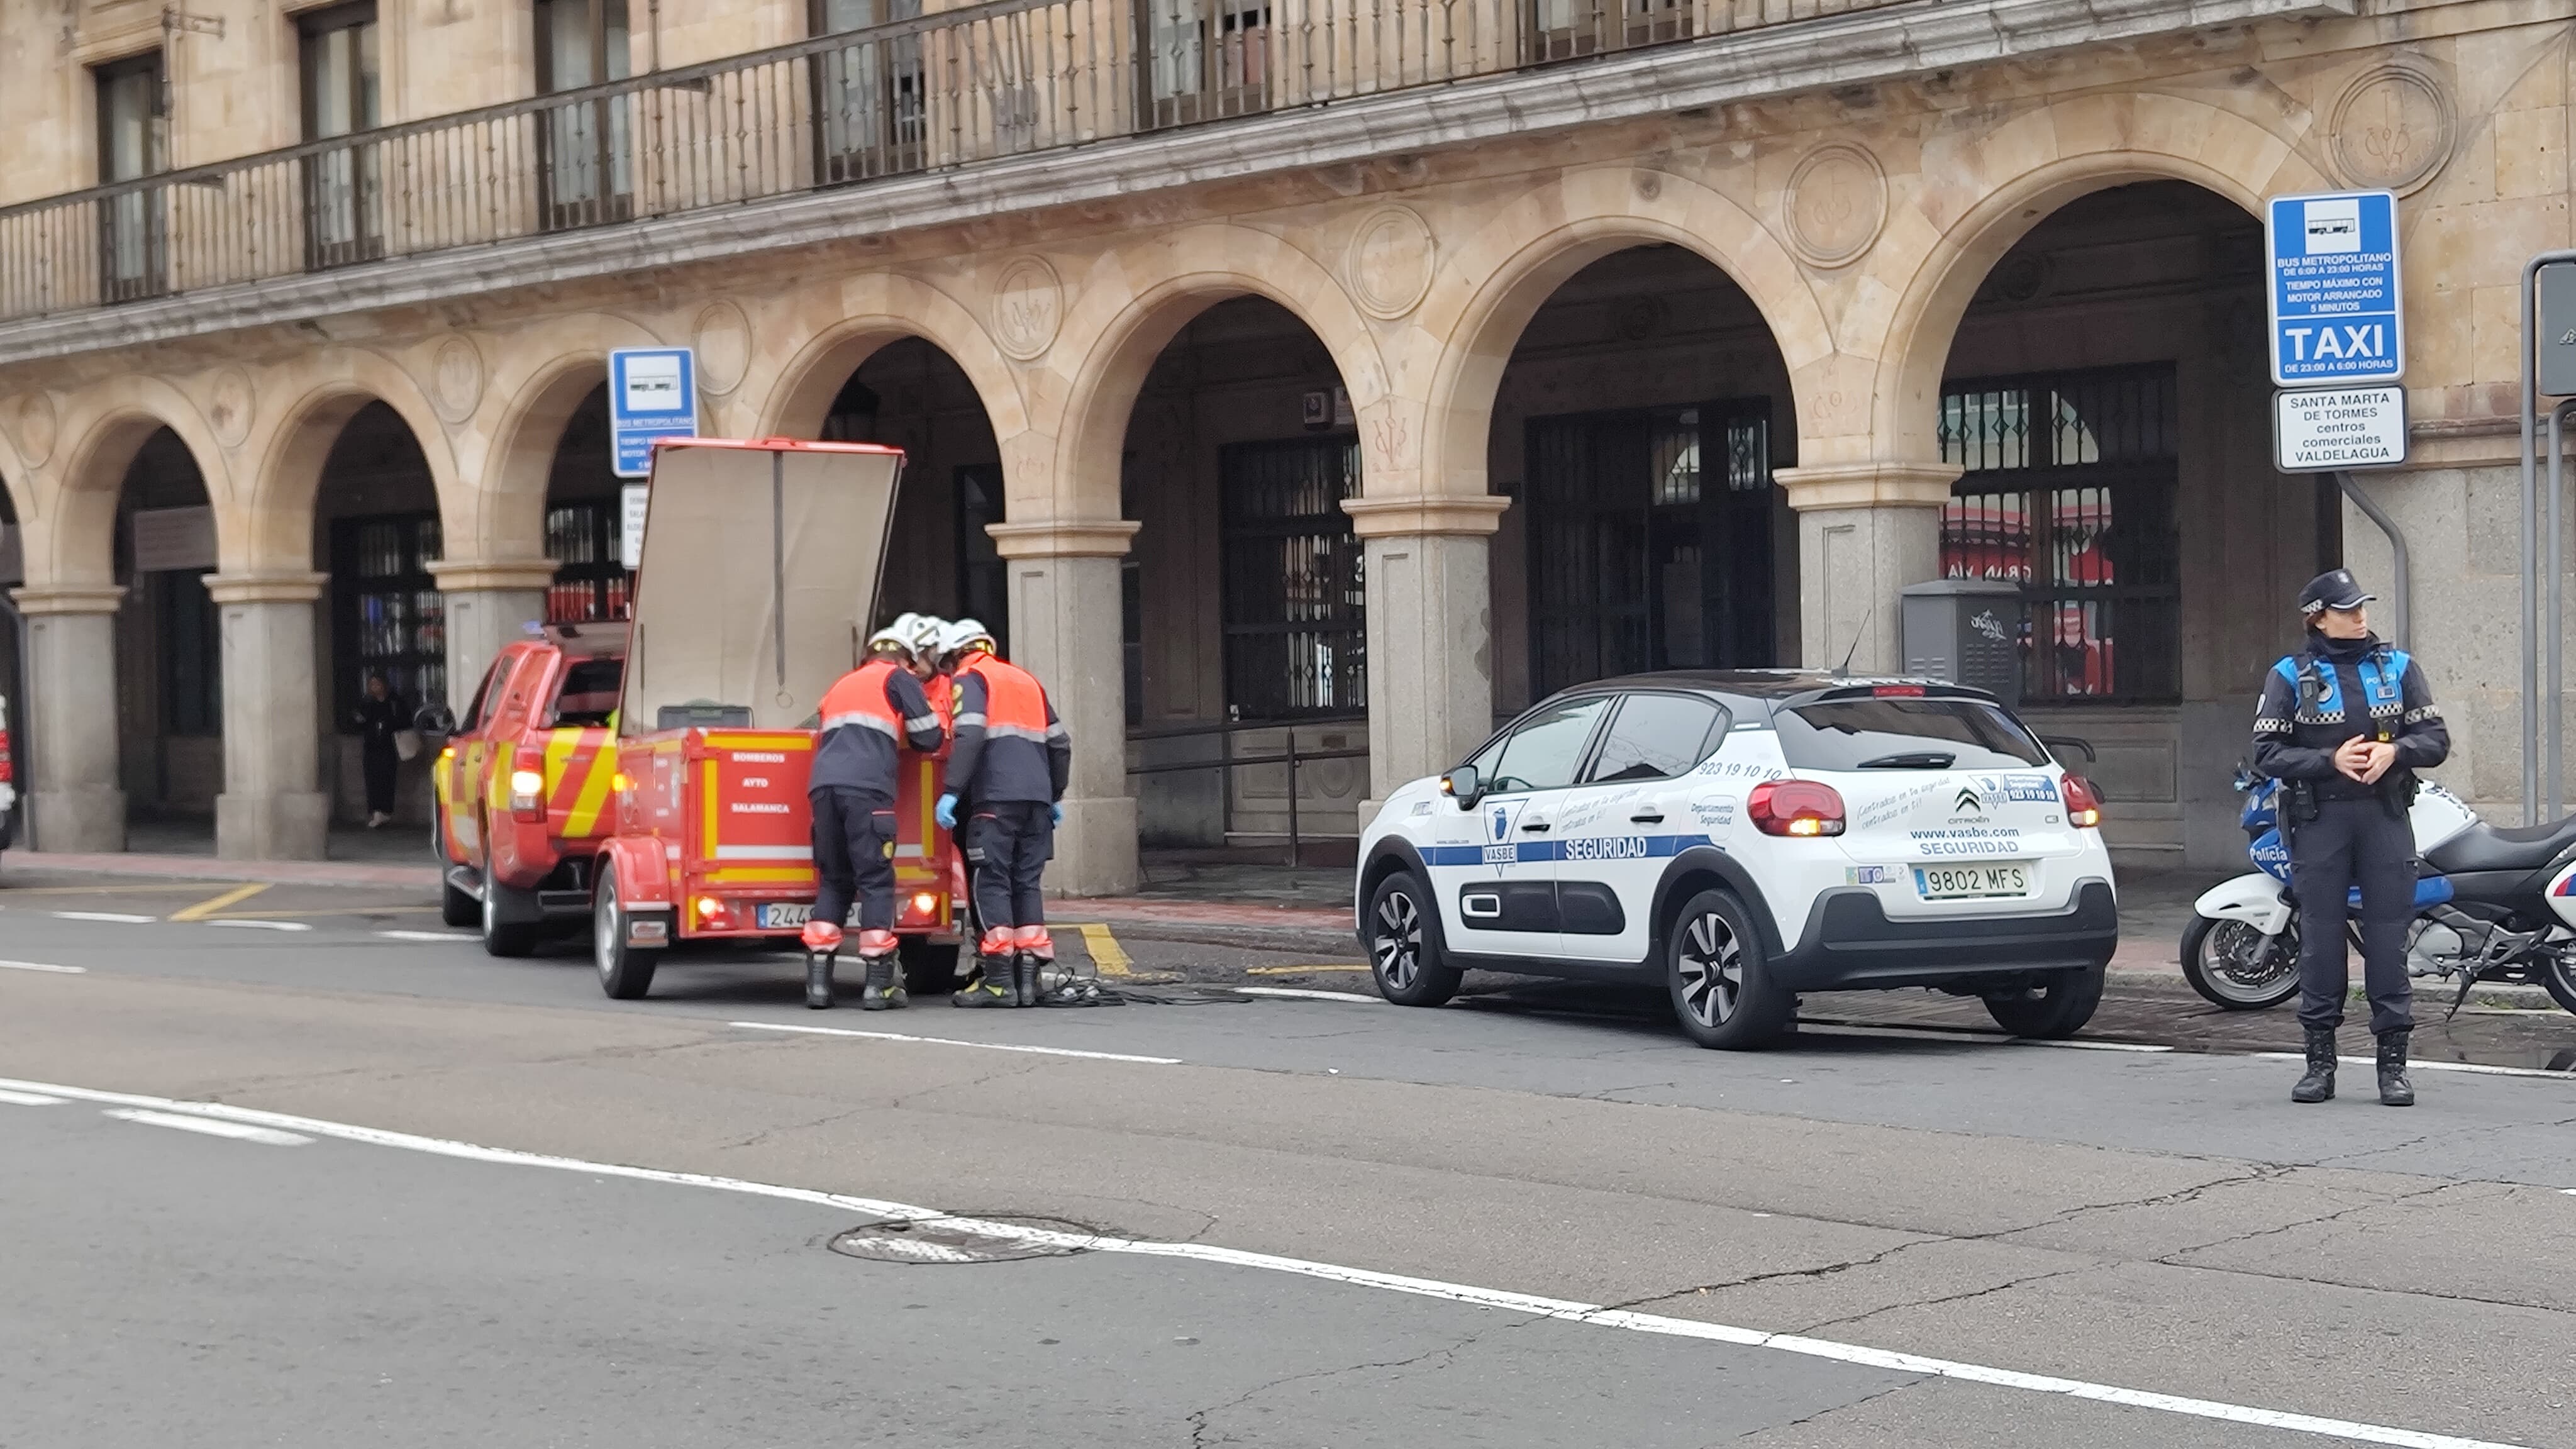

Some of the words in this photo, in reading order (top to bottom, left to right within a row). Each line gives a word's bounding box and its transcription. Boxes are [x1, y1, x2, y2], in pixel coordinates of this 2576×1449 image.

[2277, 257, 2299, 268] BUS
[2302, 253, 2392, 265] METROPOLITANO
[2284, 269, 2297, 277] DE
[2298, 267, 2316, 275] 6:00
[2326, 265, 2350, 274] 23:00
[2351, 263, 2384, 272] HORAS
[2285, 280, 2321, 291] TIEMPO
[2323, 277, 2360, 289] MÁXIMO
[2362, 277, 2383, 286] CON
[2287, 292, 2321, 303] MOTOR
[2323, 289, 2382, 301] ARRANCADO
[2318, 303, 2360, 312] MINUTOS
[2285, 325, 2384, 360] TAXI
[2285, 365, 2298, 373] DE
[2301, 363, 2325, 372] 23:00
[2328, 362, 2334, 370] A
[2337, 361, 2357, 370] 6:00
[2358, 359, 2394, 369] HORAS
[2290, 396, 2336, 409] SANTA
[2341, 393, 2390, 406] MARTA
[2304, 411, 2320, 421] DE
[2325, 408, 2378, 419] TORMES
[2317, 423, 2365, 433] centros
[2302, 435, 2381, 448] comerciales
[2296, 447, 2390, 462] VALDELAGUA
[732, 752, 785, 763] BOMBEROS
[1699, 762, 1723, 775] 923
[1726, 763, 1741, 775] 19
[1743, 765, 1761, 777] 10
[1763, 768, 1782, 780] 10
[743, 778, 769, 787] AYTO
[731, 803, 790, 814] SALAMANCA
[1911, 827, 2019, 840] www.vasbe.com
[1485, 847, 1514, 861] VASBE
[1565, 836, 1647, 860] SEGURIDAD
[1920, 840, 2019, 855] SEGURIDAD
[1929, 869, 1981, 892] 9802
[1985, 869, 2024, 890] MFS
